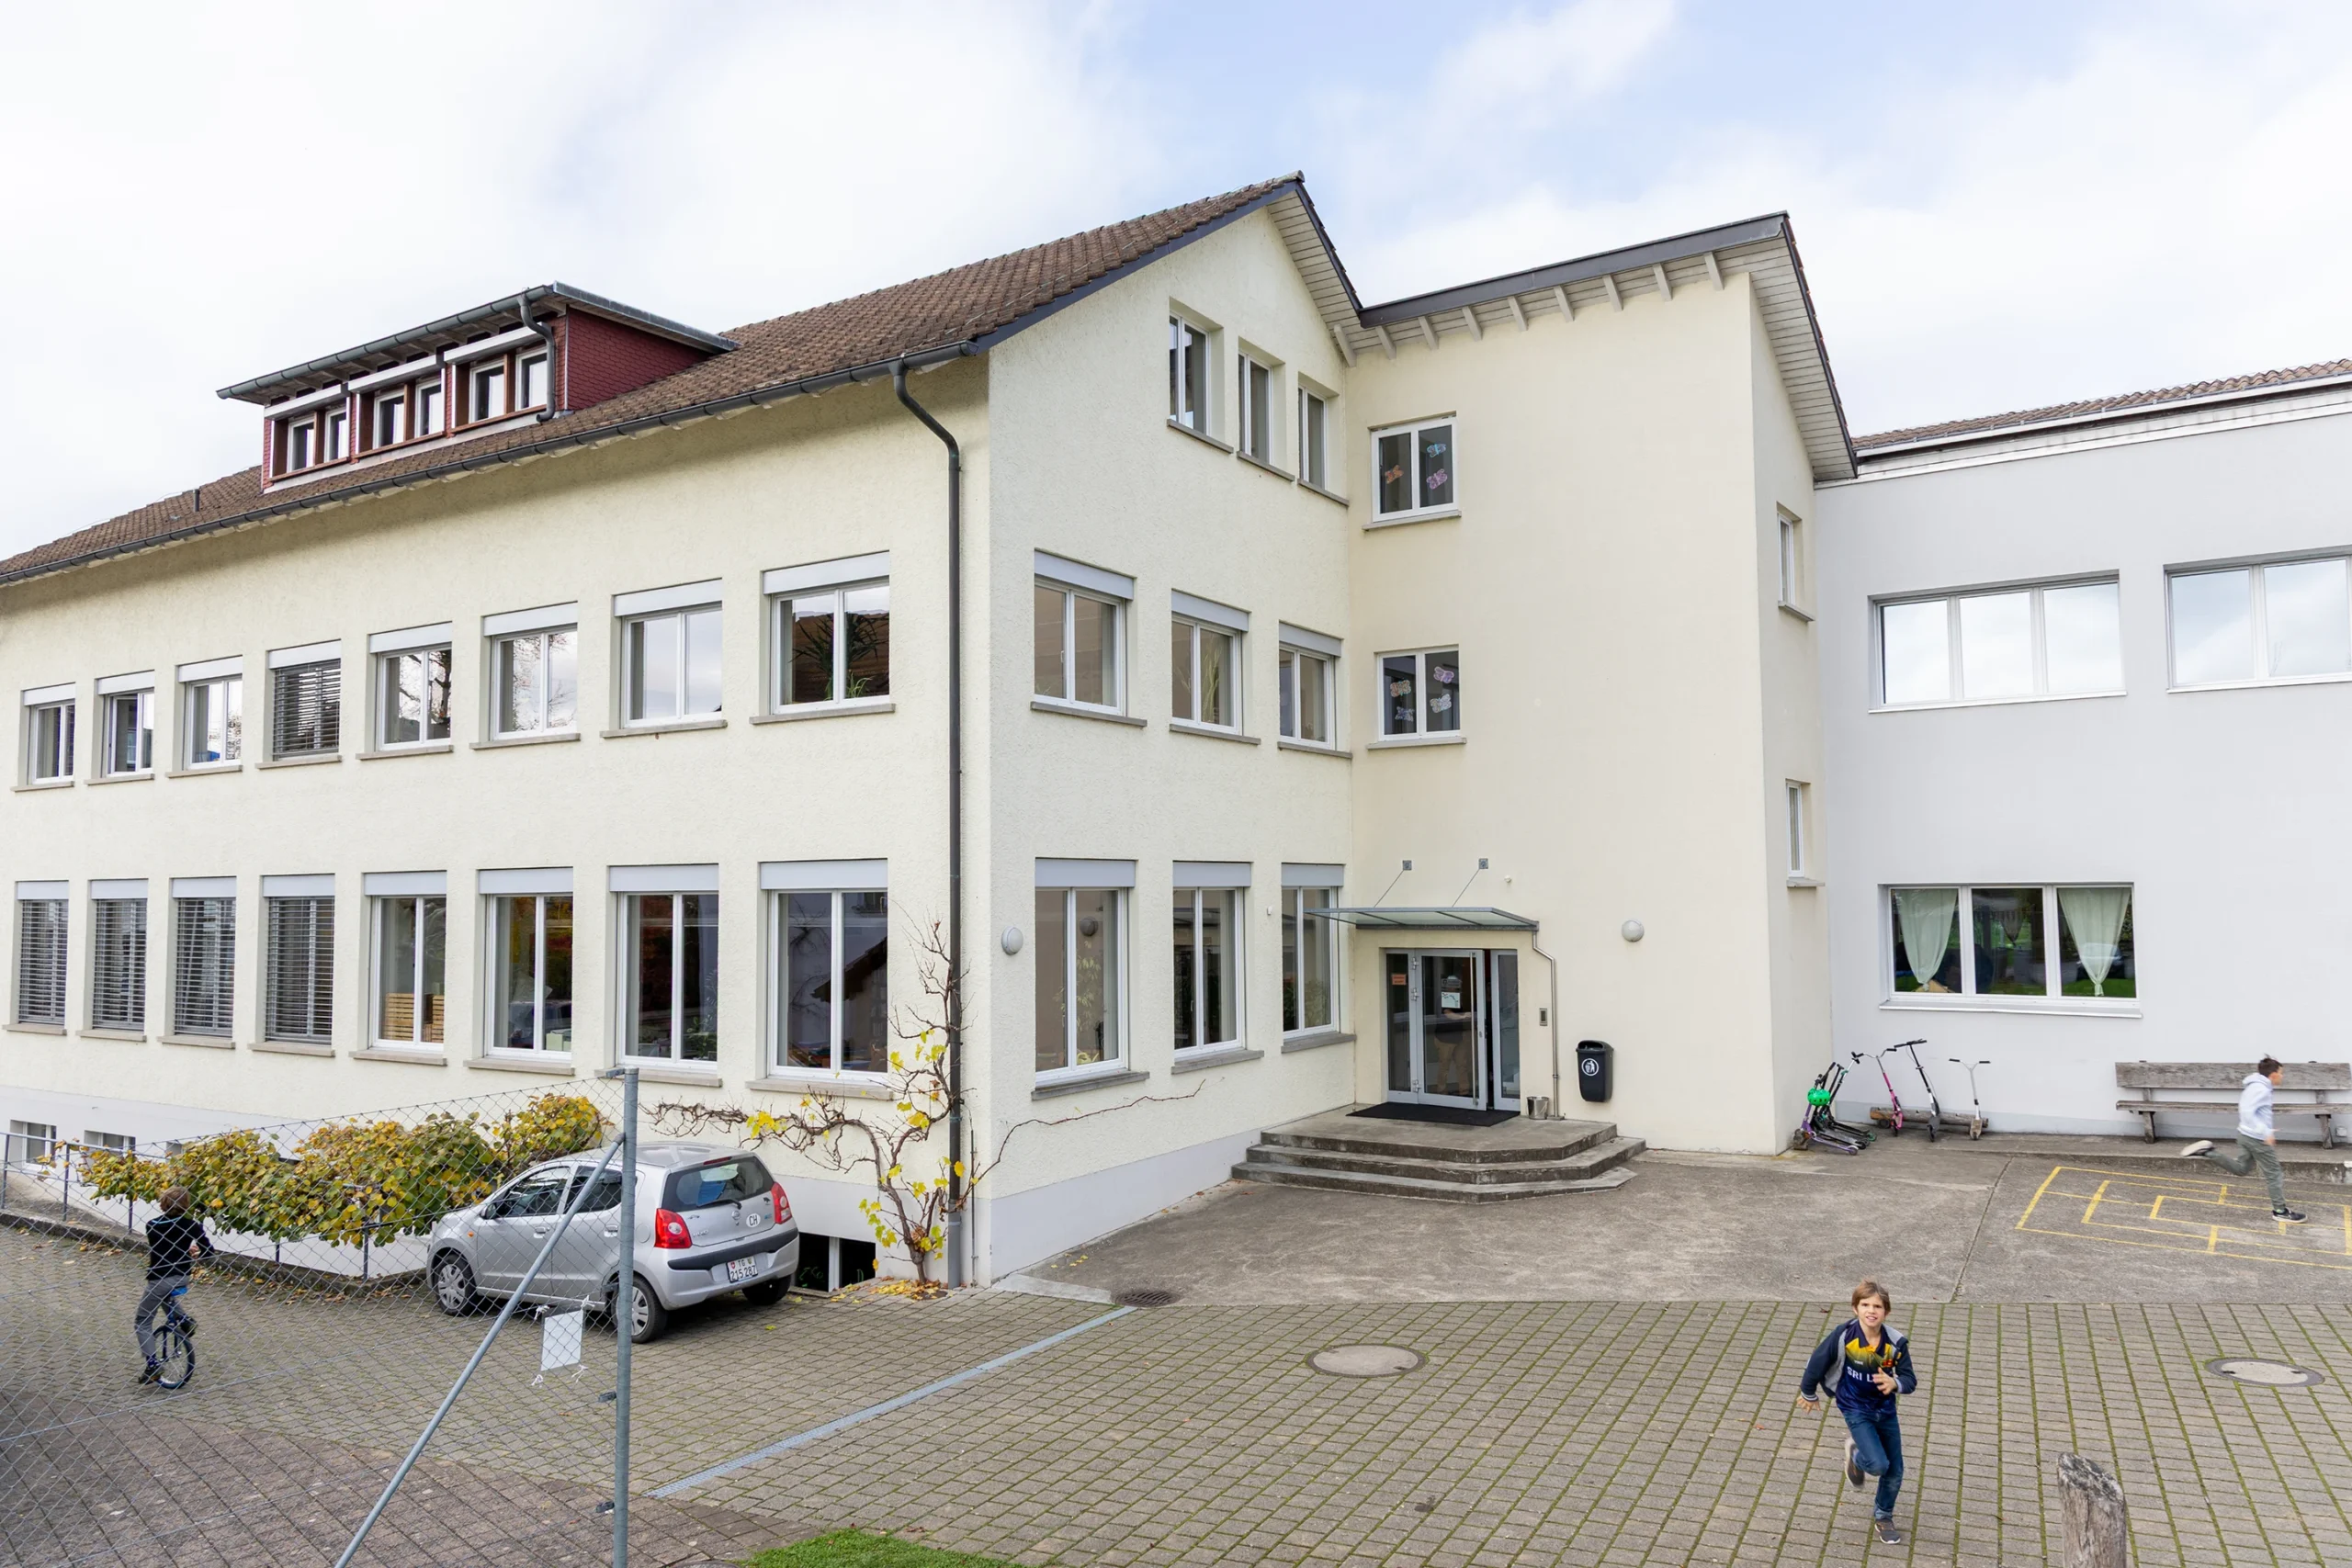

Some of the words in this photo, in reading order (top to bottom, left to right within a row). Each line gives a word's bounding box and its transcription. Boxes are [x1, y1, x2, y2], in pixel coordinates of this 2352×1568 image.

[749, 1214, 758, 1226] CH
[738, 1259, 745, 1268] TG
[730, 1269, 743, 1280] 215
[1847, 1366, 1862, 1381] SRI
